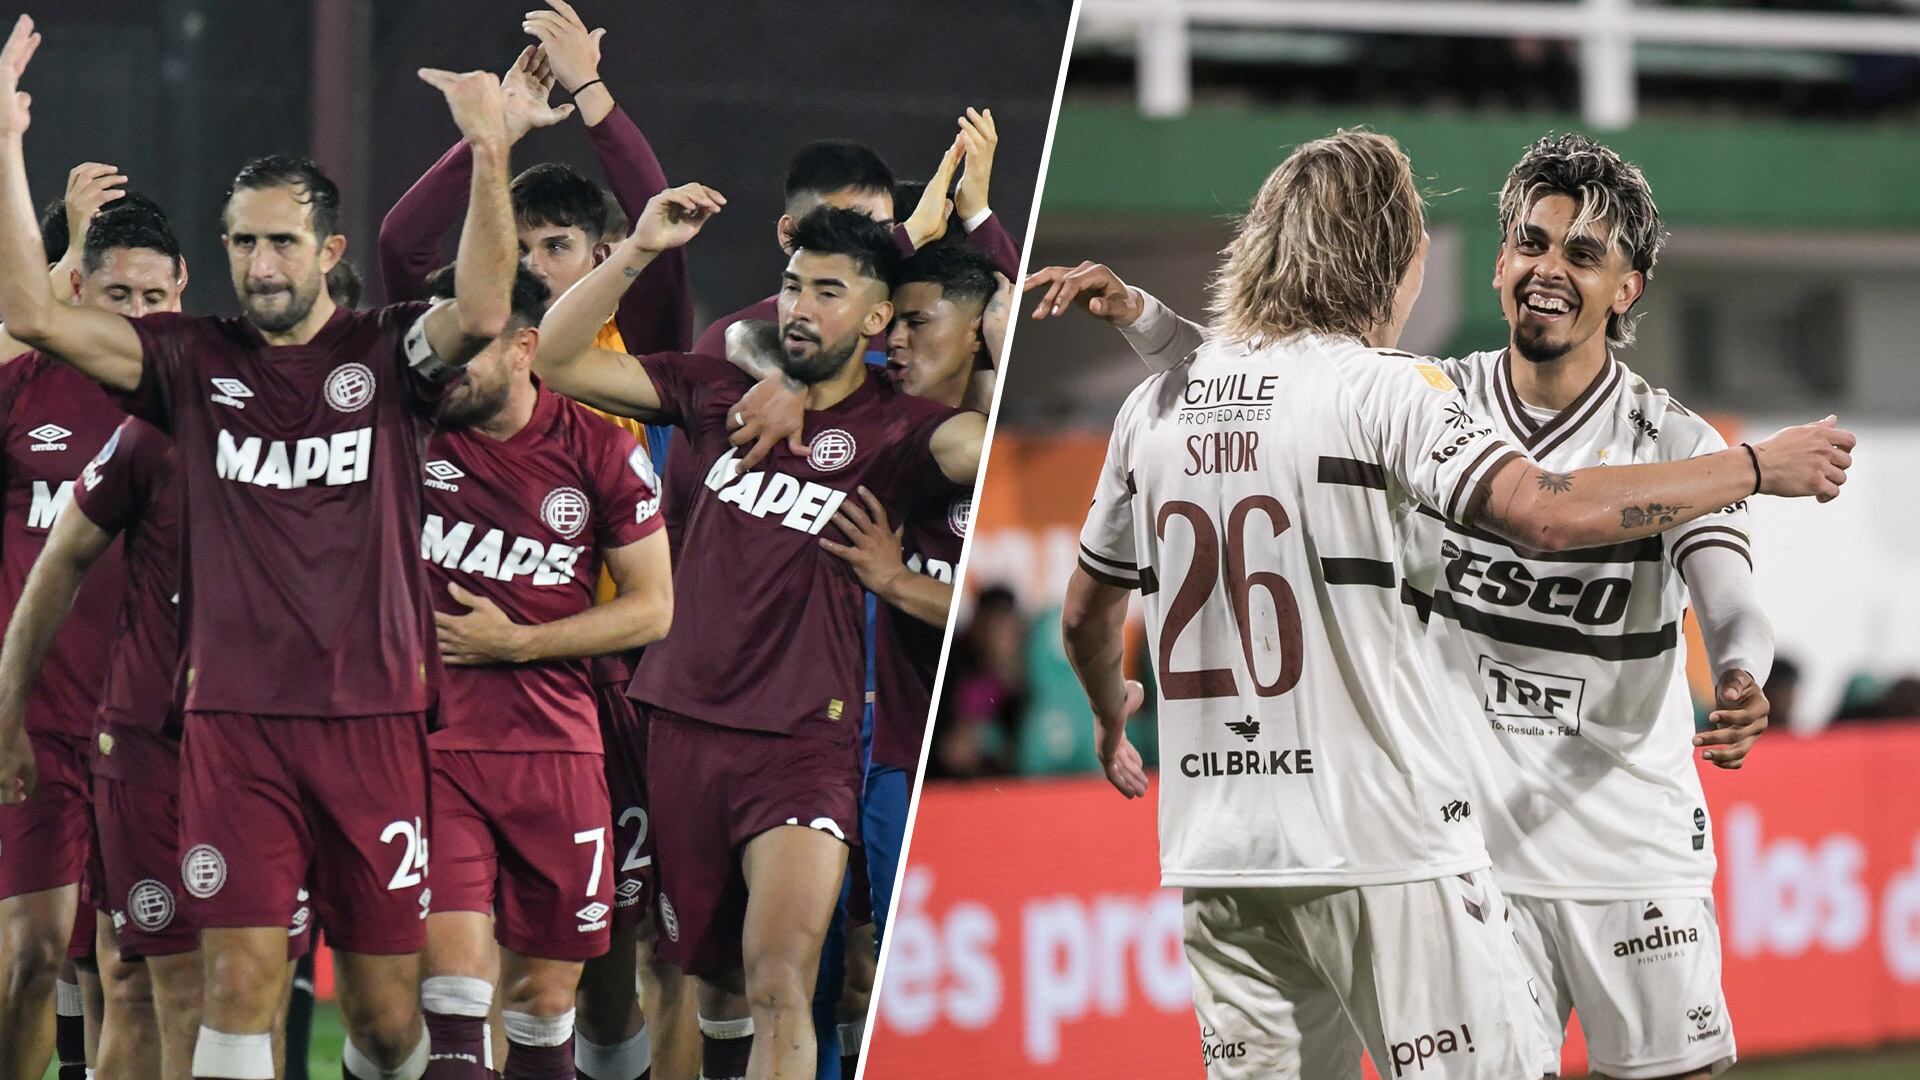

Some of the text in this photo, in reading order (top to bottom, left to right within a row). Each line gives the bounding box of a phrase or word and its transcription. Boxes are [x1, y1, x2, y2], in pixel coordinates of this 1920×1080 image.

[1184, 373, 1279, 405] CIVILE
[1177, 408, 1272, 425] PROPIEDADES
[30, 442, 67, 452] umbro
[216, 427, 373, 490] MAPEI
[1184, 430, 1260, 477] SCHOR
[1156, 494, 1304, 701] 26
[1488, 668, 1572, 715] TRF
[1507, 724, 1545, 736] Resulta
[573, 827, 606, 897] 7
[1724, 803, 1873, 960] los
[1613, 926, 1698, 958] andina
[1637, 949, 1686, 966] PINTURAS
[1020, 890, 1191, 1066] pro
[1687, 1024, 1722, 1045] hummel
